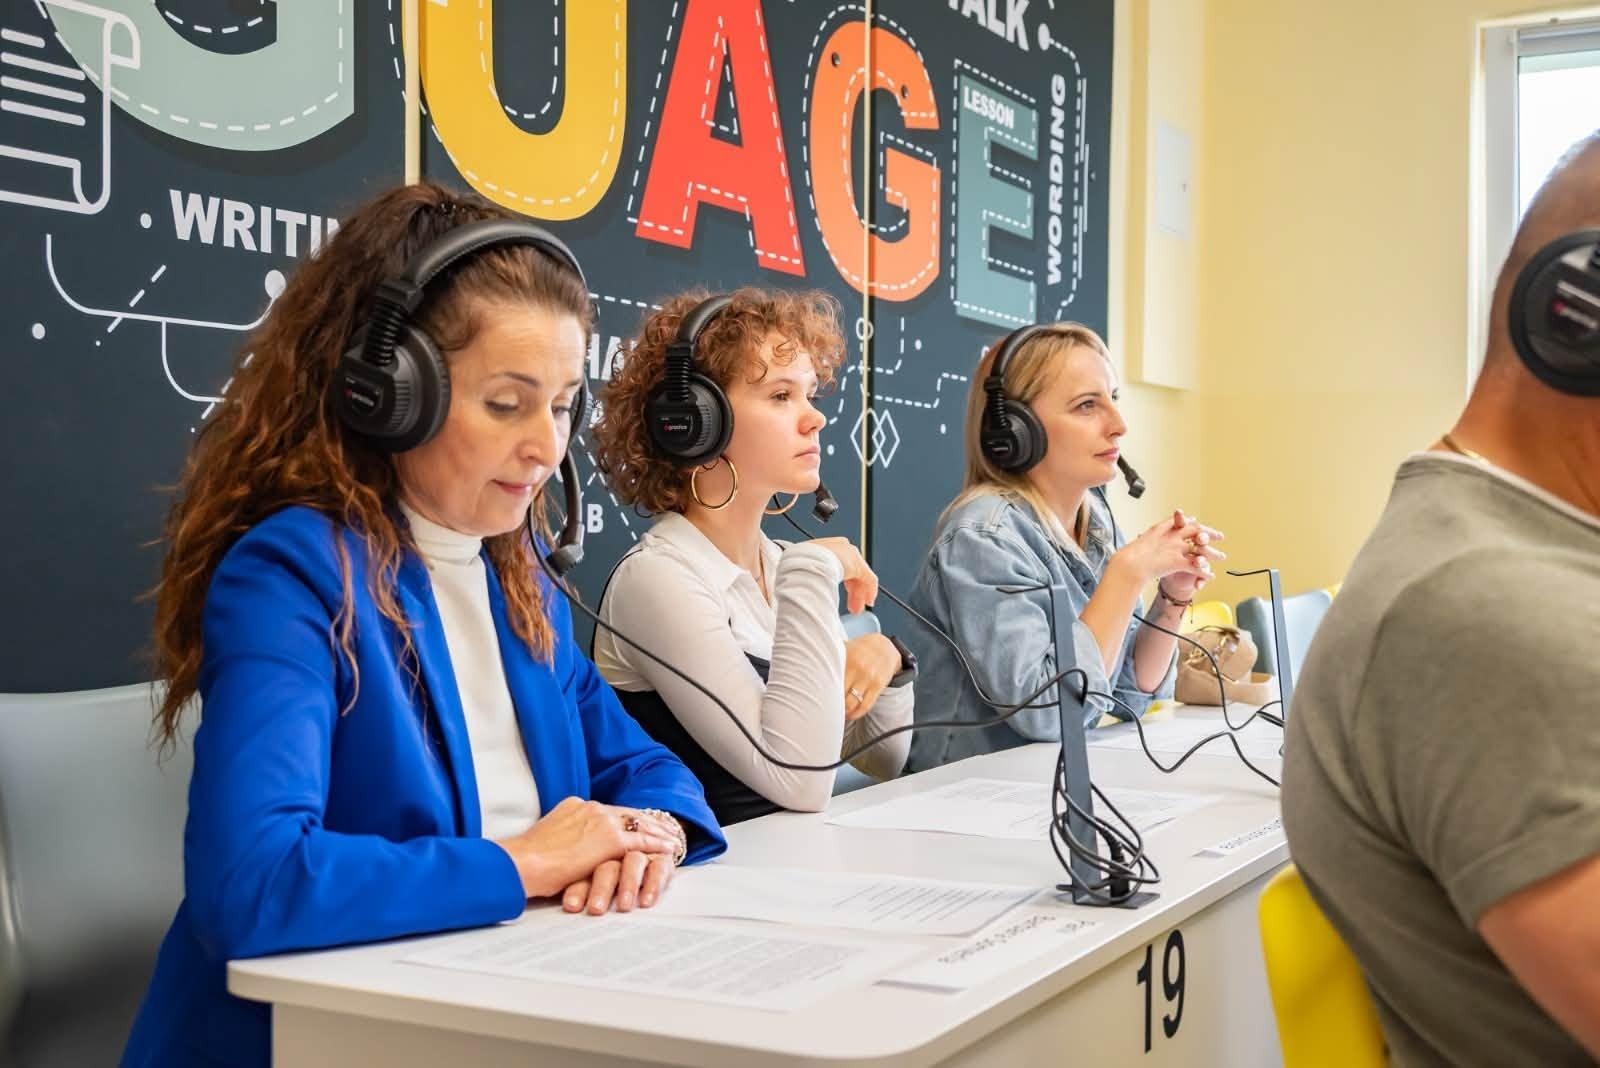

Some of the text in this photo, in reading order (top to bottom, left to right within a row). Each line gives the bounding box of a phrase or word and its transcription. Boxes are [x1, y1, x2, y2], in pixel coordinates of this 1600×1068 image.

[948, 0, 1030, 52] LK
[963, 85, 1015, 130] LESSON
[1047, 74, 1066, 285] WORDING
[169, 189, 341, 260] WRITI
[1136, 929, 1186, 1054] 19
